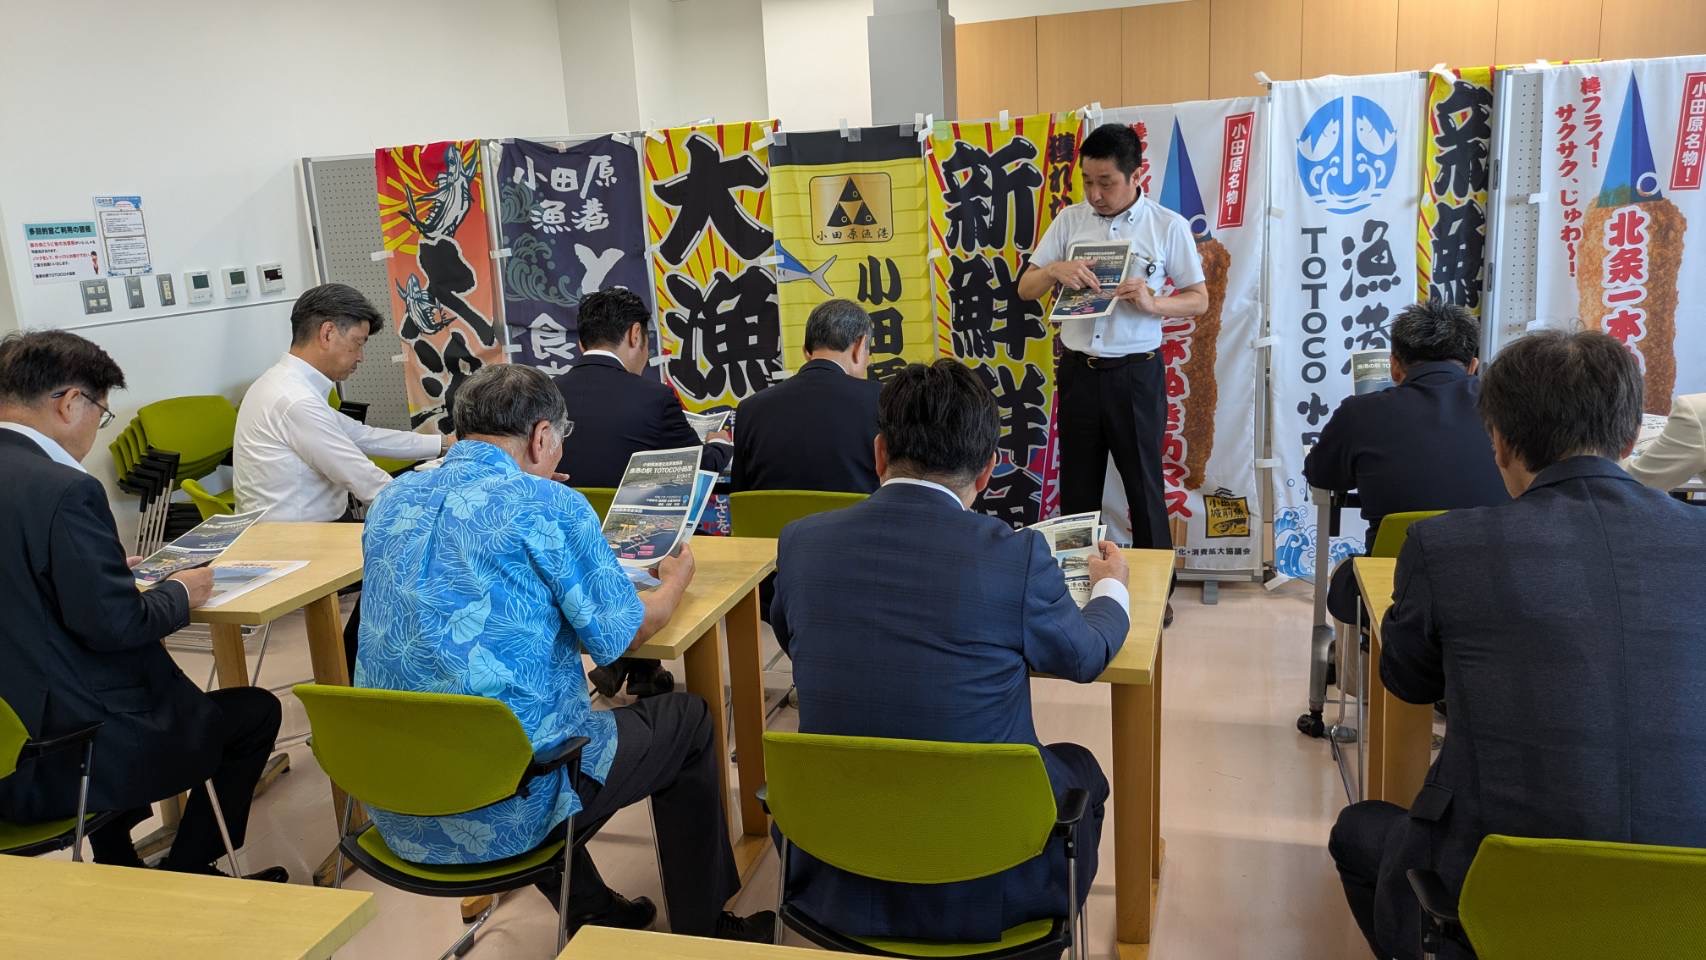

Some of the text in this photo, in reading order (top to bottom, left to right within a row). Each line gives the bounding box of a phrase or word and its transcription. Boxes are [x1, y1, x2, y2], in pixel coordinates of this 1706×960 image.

[1579, 76, 1603, 168] 棒フライ!
[1681, 81, 1706, 182] 小田原名物!
[512, 154, 618, 200] 小田原
[530, 197, 610, 235] 漁港
[1225, 122, 1247, 220] 小田原名物!
[652, 133, 782, 401] 大漁
[816, 227, 890, 242] 小田原漁港
[1607, 210, 1645, 362] 北条一本
[1174, 547, 1251, 556] 化・消費拡大協議会
